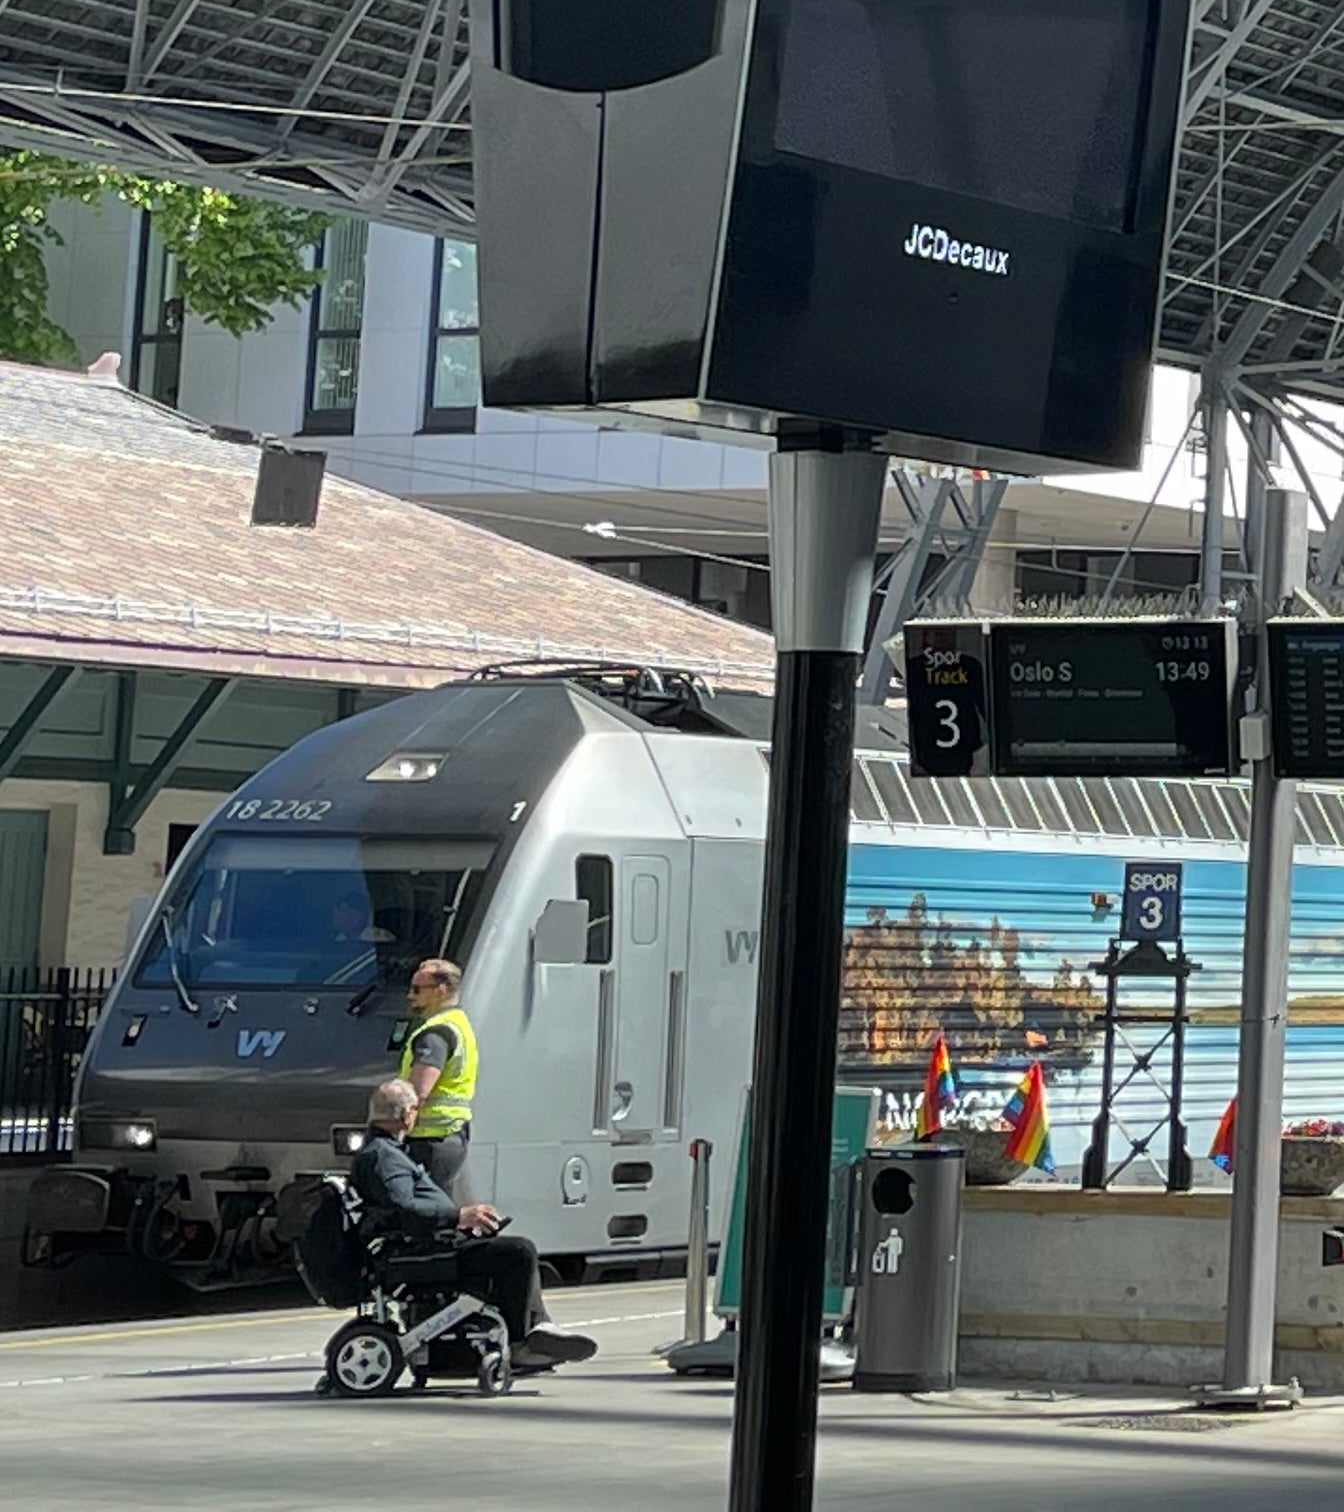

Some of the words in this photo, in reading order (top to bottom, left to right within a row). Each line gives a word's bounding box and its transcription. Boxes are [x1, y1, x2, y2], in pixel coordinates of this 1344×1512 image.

[903, 222, 1010, 277] JCDecaux
[923, 647, 961, 666] Spor
[924, 666, 968, 684] Track
[1009, 661, 1053, 682] Oslo
[1058, 661, 1073, 682] S
[1154, 661, 1210, 682] 13:49
[934, 699, 961, 748] 3
[225, 799, 257, 820] 18
[259, 799, 332, 821] 2262
[508, 800, 526, 822] 1
[1129, 873, 1178, 892] SPOR
[1139, 896, 1163, 930] 3
